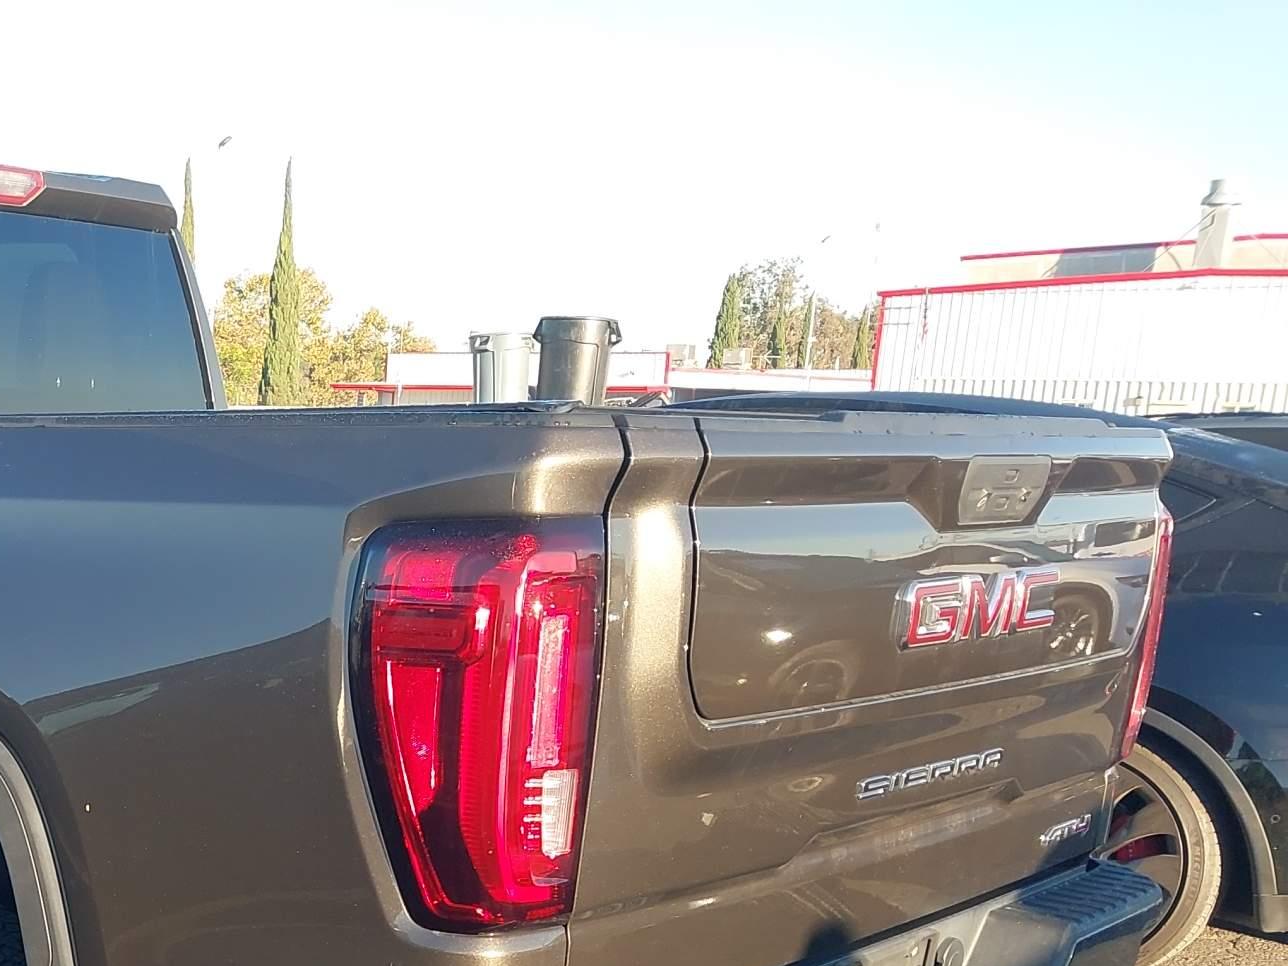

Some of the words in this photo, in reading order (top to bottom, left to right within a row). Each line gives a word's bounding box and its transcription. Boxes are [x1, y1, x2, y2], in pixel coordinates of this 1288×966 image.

[900, 568, 1060, 648] GMC
[855, 747, 1005, 800] SIERRA
[1039, 813, 1091, 846] AT4
